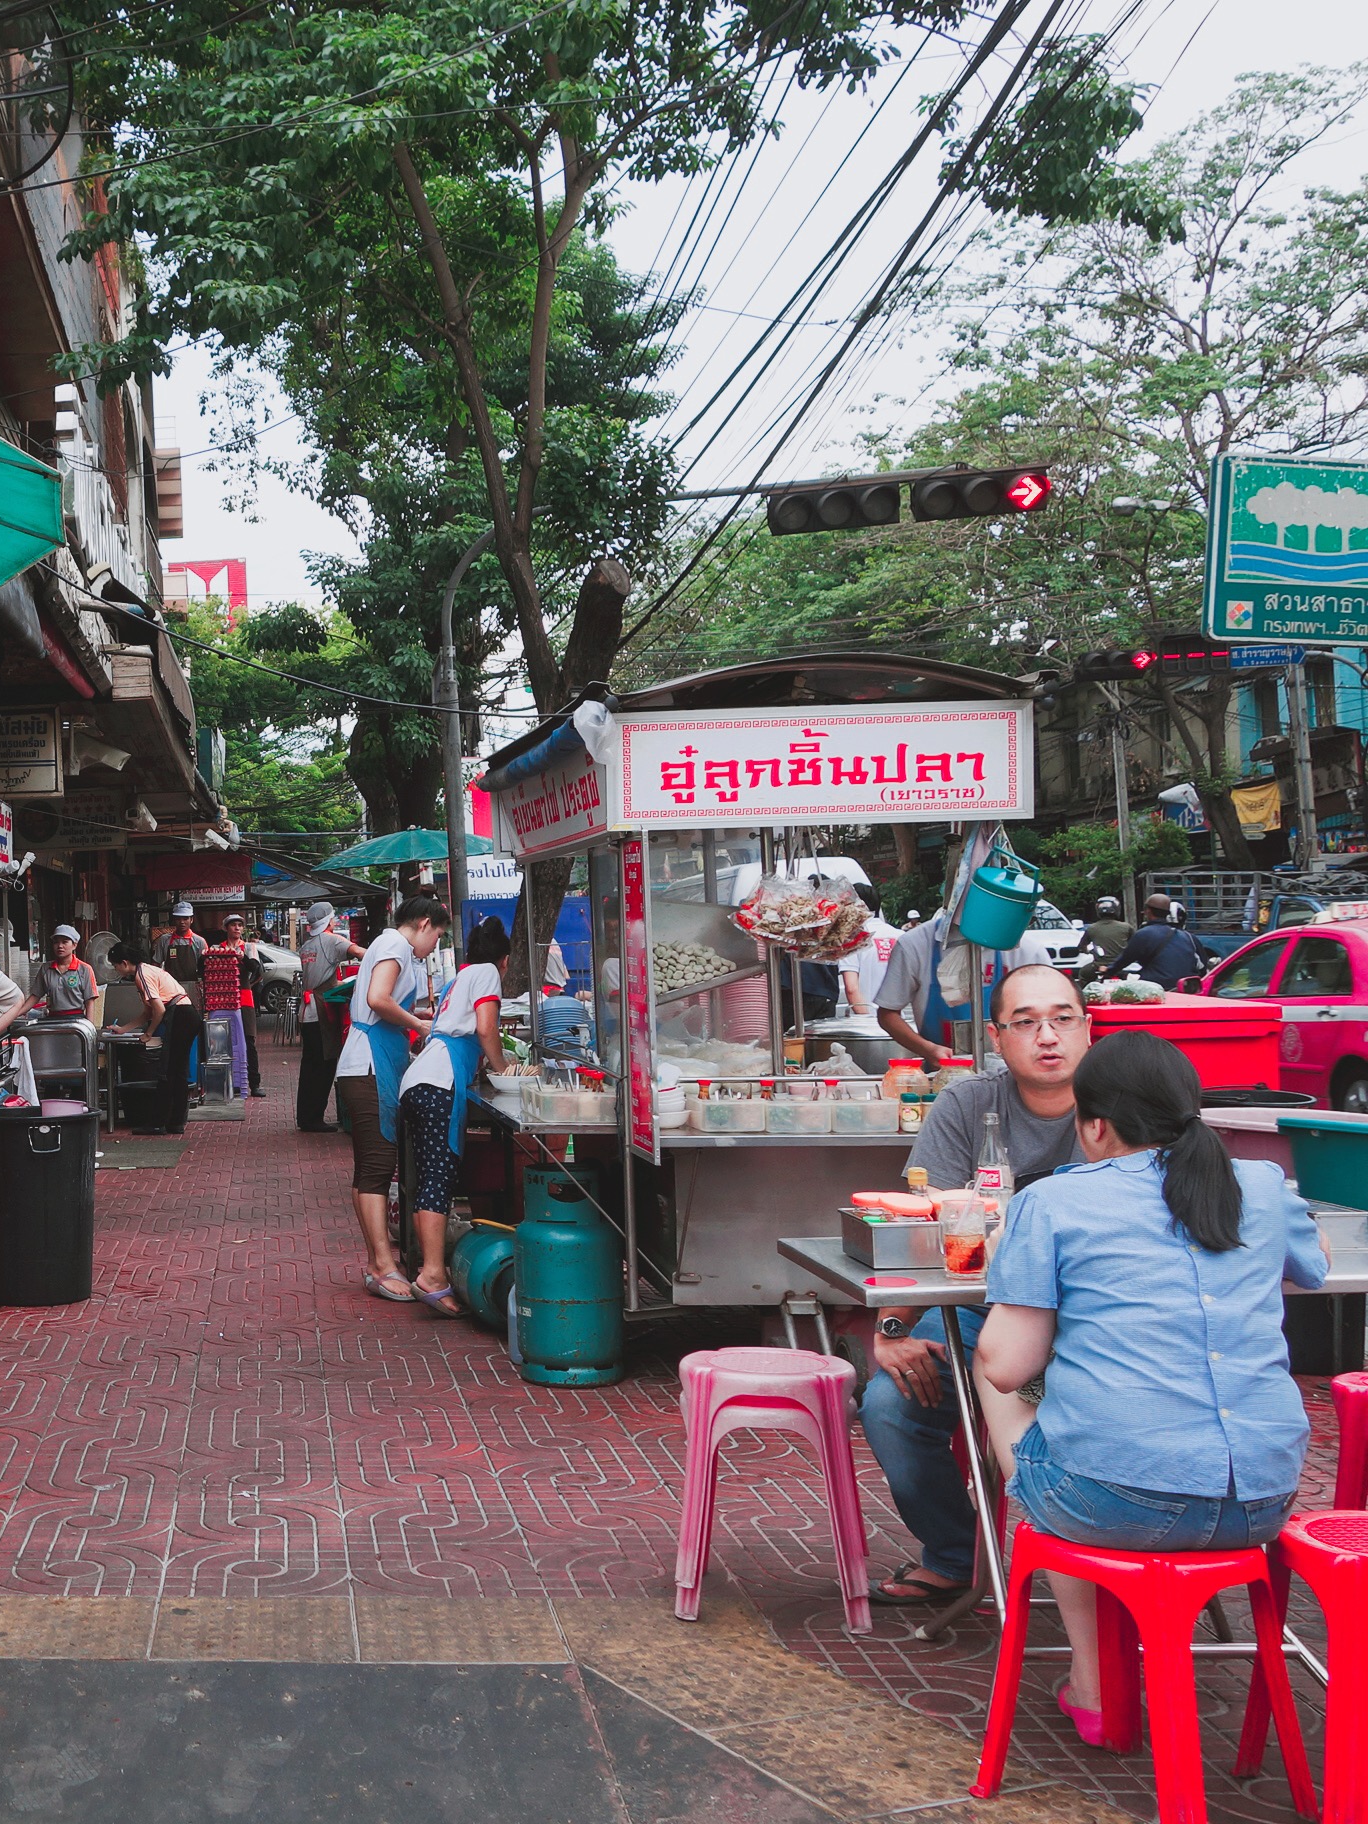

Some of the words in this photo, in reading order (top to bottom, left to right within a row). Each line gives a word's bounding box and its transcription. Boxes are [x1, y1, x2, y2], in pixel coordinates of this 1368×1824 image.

[1264, 592, 1368, 614] สวนสาธา
[660, 729, 987, 804] อู๋ลูกชิ้นปลา
[880, 784, 986, 806] (เยาวราช)
